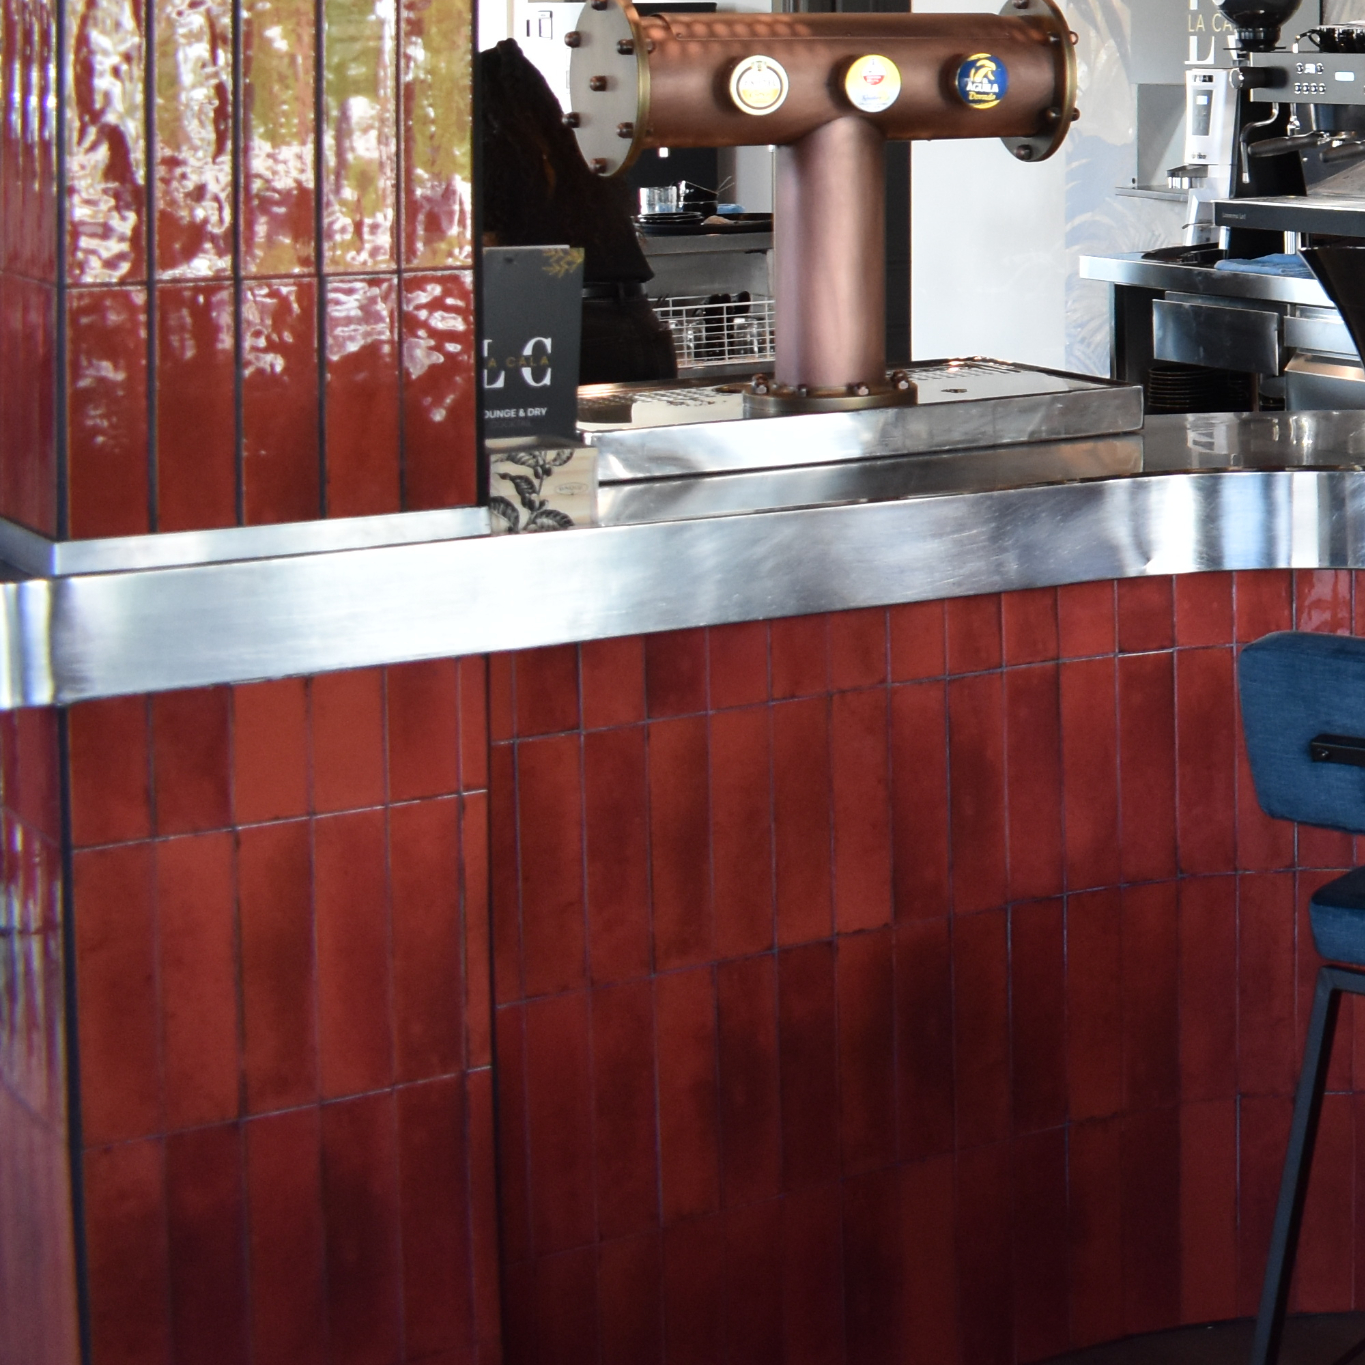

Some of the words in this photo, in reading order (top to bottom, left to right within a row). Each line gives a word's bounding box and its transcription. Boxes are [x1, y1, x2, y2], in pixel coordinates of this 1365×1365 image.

[1188, 13, 1206, 32] LA
[1212, 13, 1233, 32] CA
[506, 356, 549, 368] CALA
[484, 409, 517, 419] OUNGE
[518, 408, 526, 418] &
[527, 407, 548, 417] DRY
